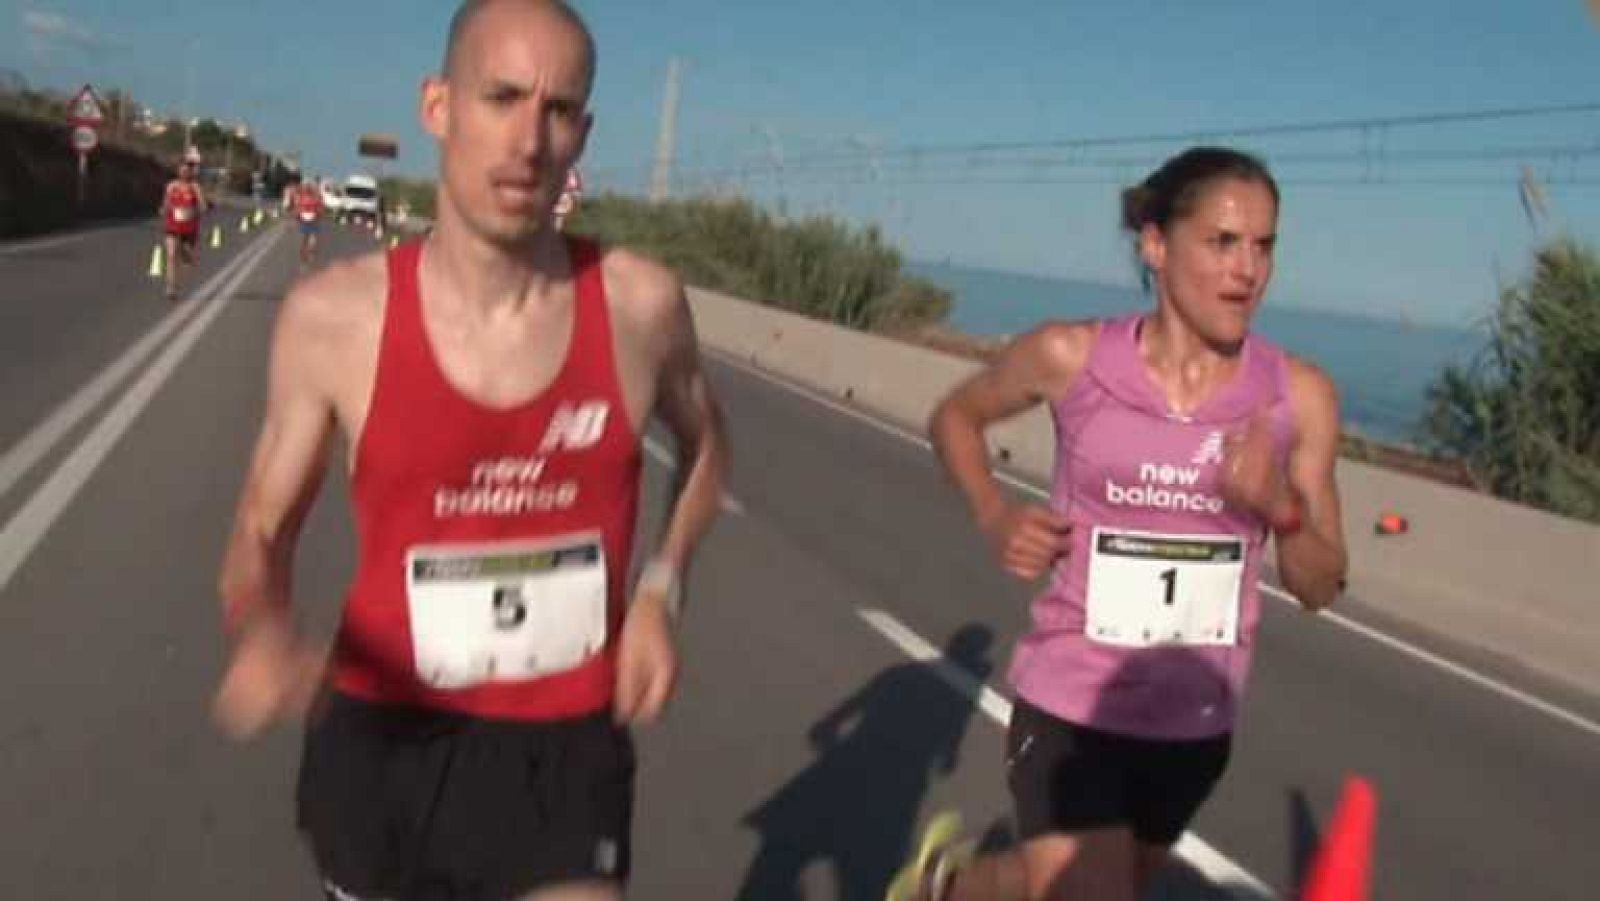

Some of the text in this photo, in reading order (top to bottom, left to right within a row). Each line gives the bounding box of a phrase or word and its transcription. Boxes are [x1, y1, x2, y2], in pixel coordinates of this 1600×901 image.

[472, 456, 546, 485] new
[1140, 463, 1199, 484] new
[1106, 478, 1224, 513] balance
[1160, 567, 1178, 606] 1
[493, 586, 527, 630] 5
